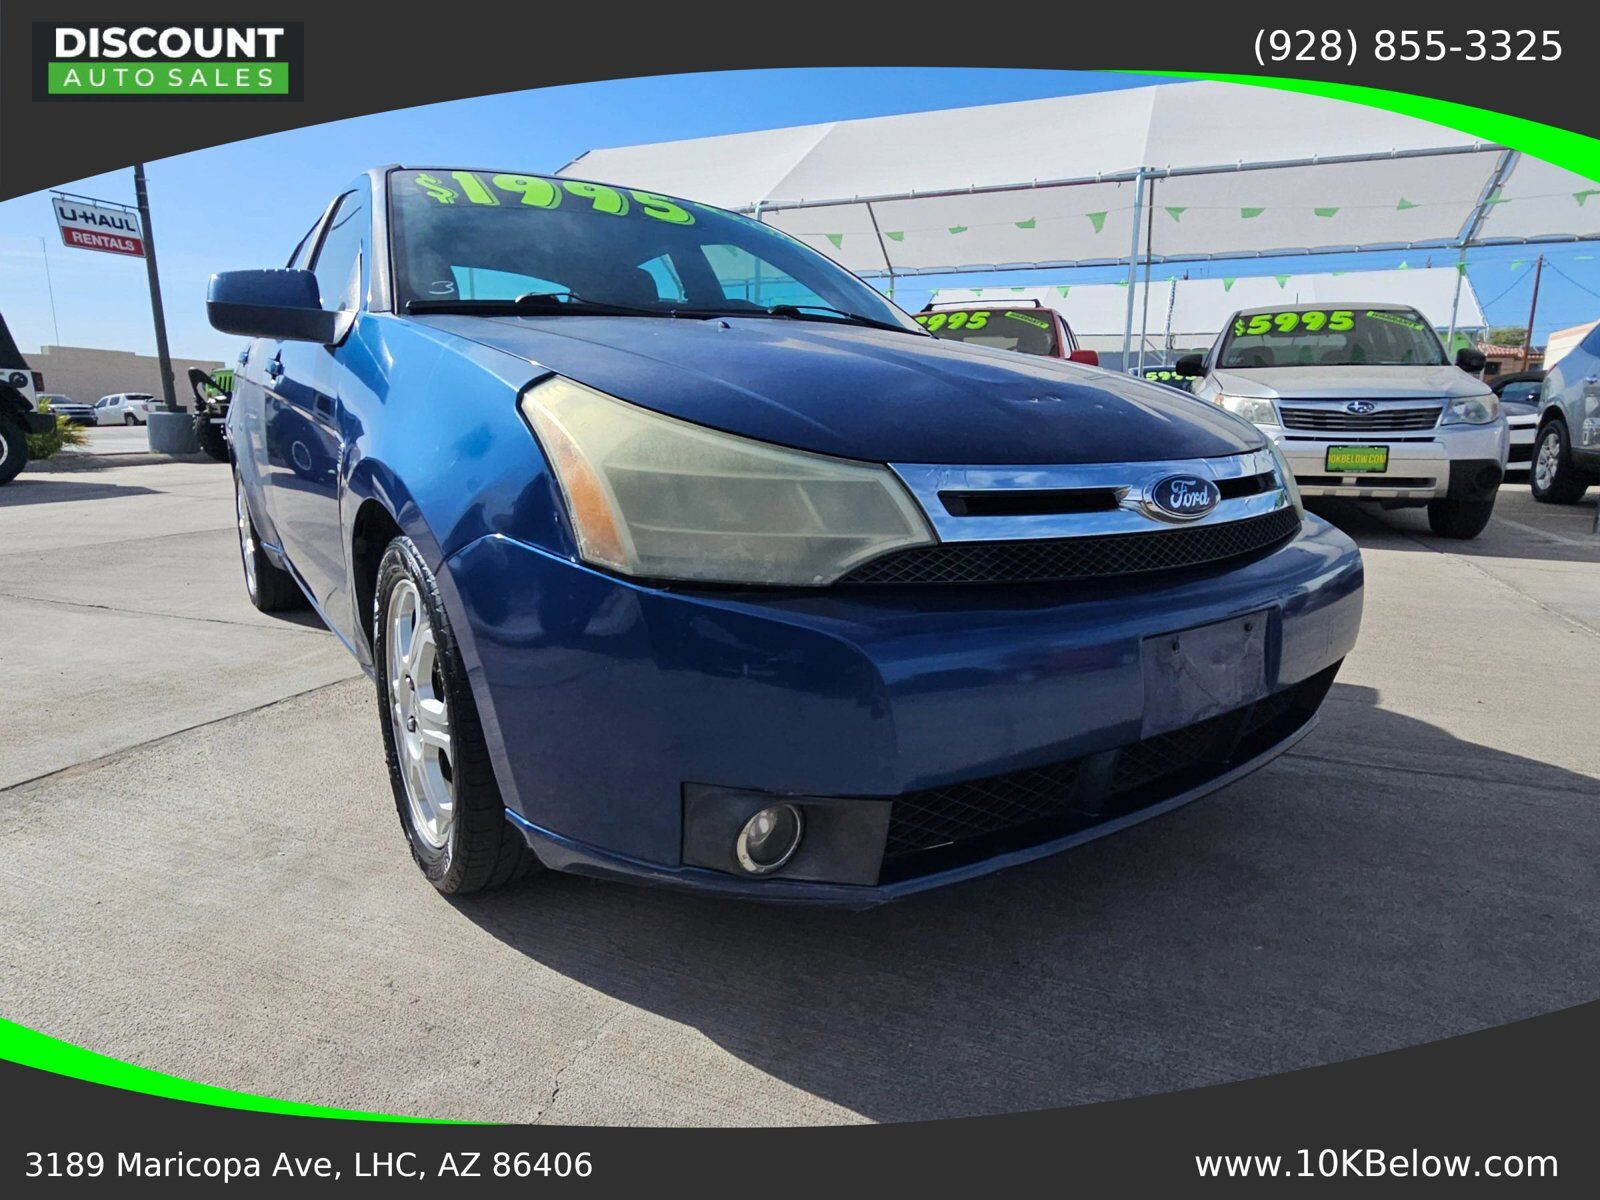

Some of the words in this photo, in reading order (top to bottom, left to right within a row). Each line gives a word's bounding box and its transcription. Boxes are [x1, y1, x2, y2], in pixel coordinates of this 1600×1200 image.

[415, 171, 696, 226] $1995
[58, 206, 137, 233] U-HAUL
[71, 231, 135, 251] RENTALS
[1234, 310, 1355, 337] $5995
[1169, 479, 1210, 508] Ford
